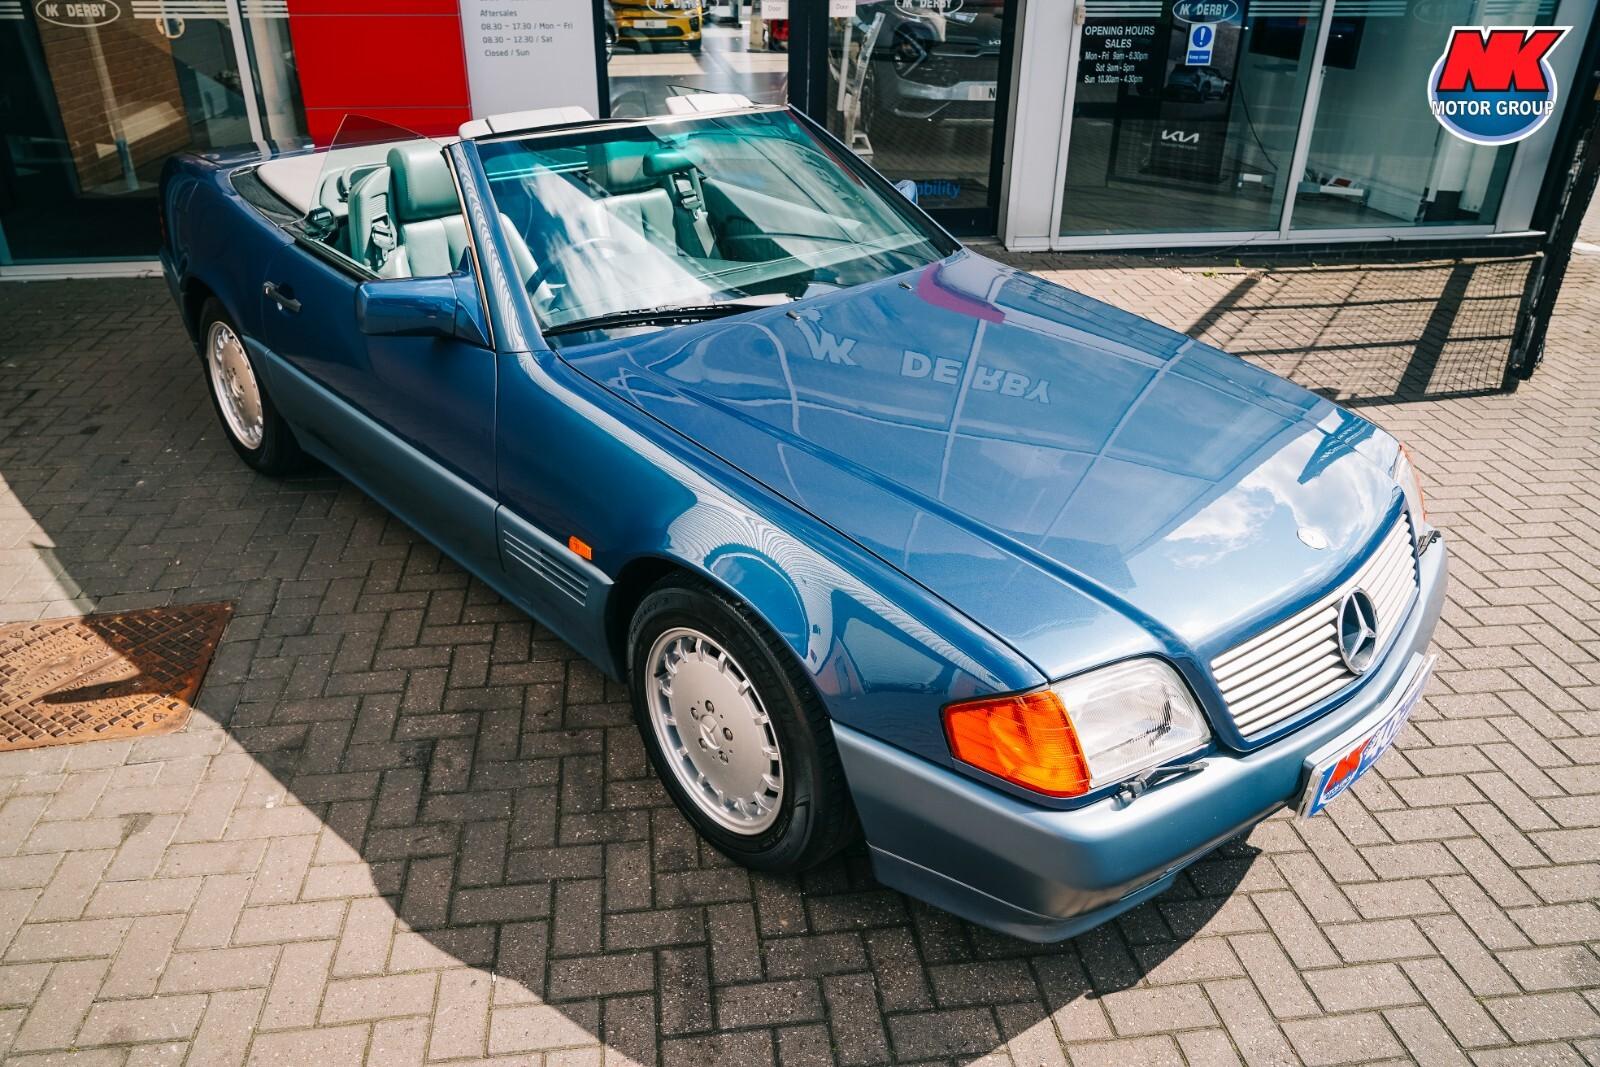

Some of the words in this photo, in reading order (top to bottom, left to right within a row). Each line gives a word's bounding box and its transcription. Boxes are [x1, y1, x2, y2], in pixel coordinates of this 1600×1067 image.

[66, 3, 106, 18] DERBY
[480, 9, 518, 17] Aftersales
[1196, 3, 1229, 17] DERBY
[481, 22, 503, 31] 08.30
[539, 22, 555, 30] Mon
[563, 22, 573, 30] Fri
[1085, 25, 1124, 36] OPENING
[1125, 25, 1156, 36] HOURS
[1104, 38, 1132, 49] SALES
[484, 49, 509, 57] Closed
